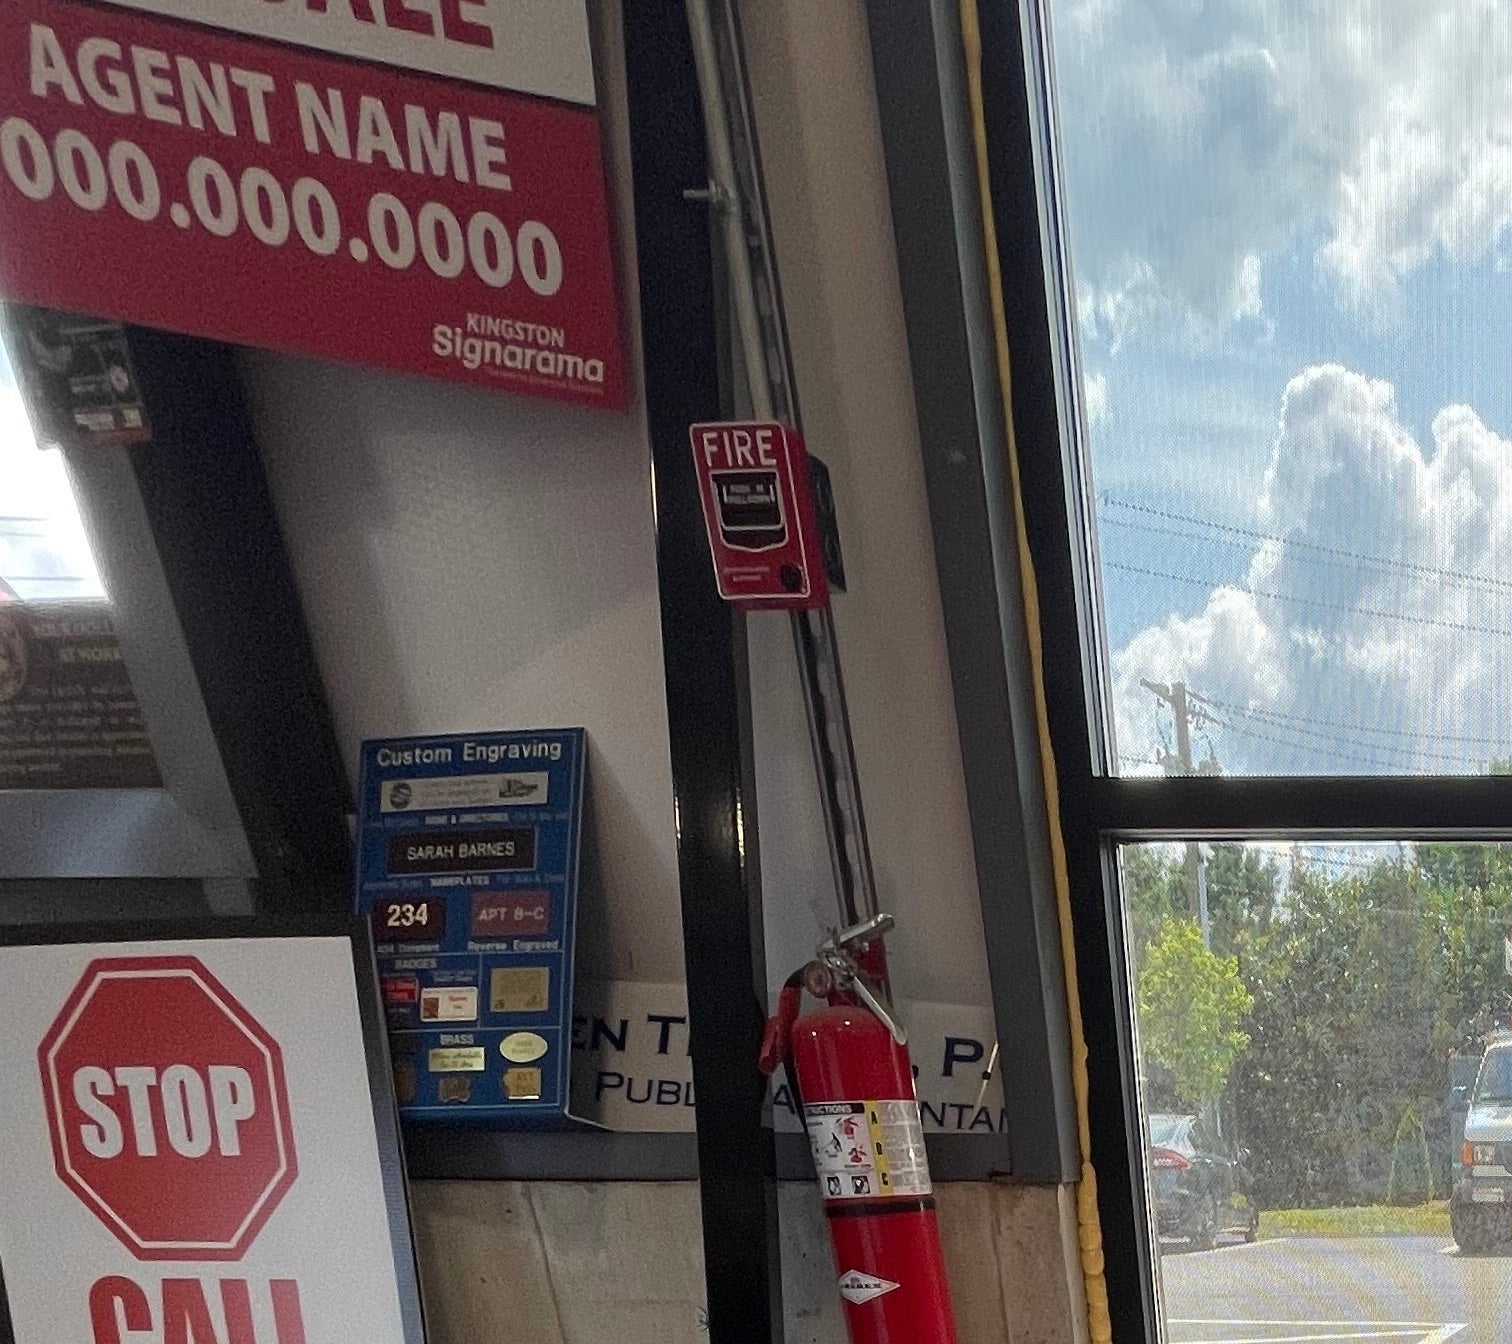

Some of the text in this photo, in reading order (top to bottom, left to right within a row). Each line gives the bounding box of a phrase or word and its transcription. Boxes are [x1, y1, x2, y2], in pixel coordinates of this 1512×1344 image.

[29, 22, 275, 145] AGENT
[294, 80, 513, 191] NAME
[465, 312, 565, 349] KINGSTON
[431, 323, 605, 384] Signarama
[702, 428, 777, 467] FIRE
[376, 740, 562, 767] Custom Engraving
[406, 840, 515, 862] SARAH BARNES
[386, 903, 428, 927] 234
[478, 908, 507, 921] APT
[72, 1063, 256, 1159] STOP
